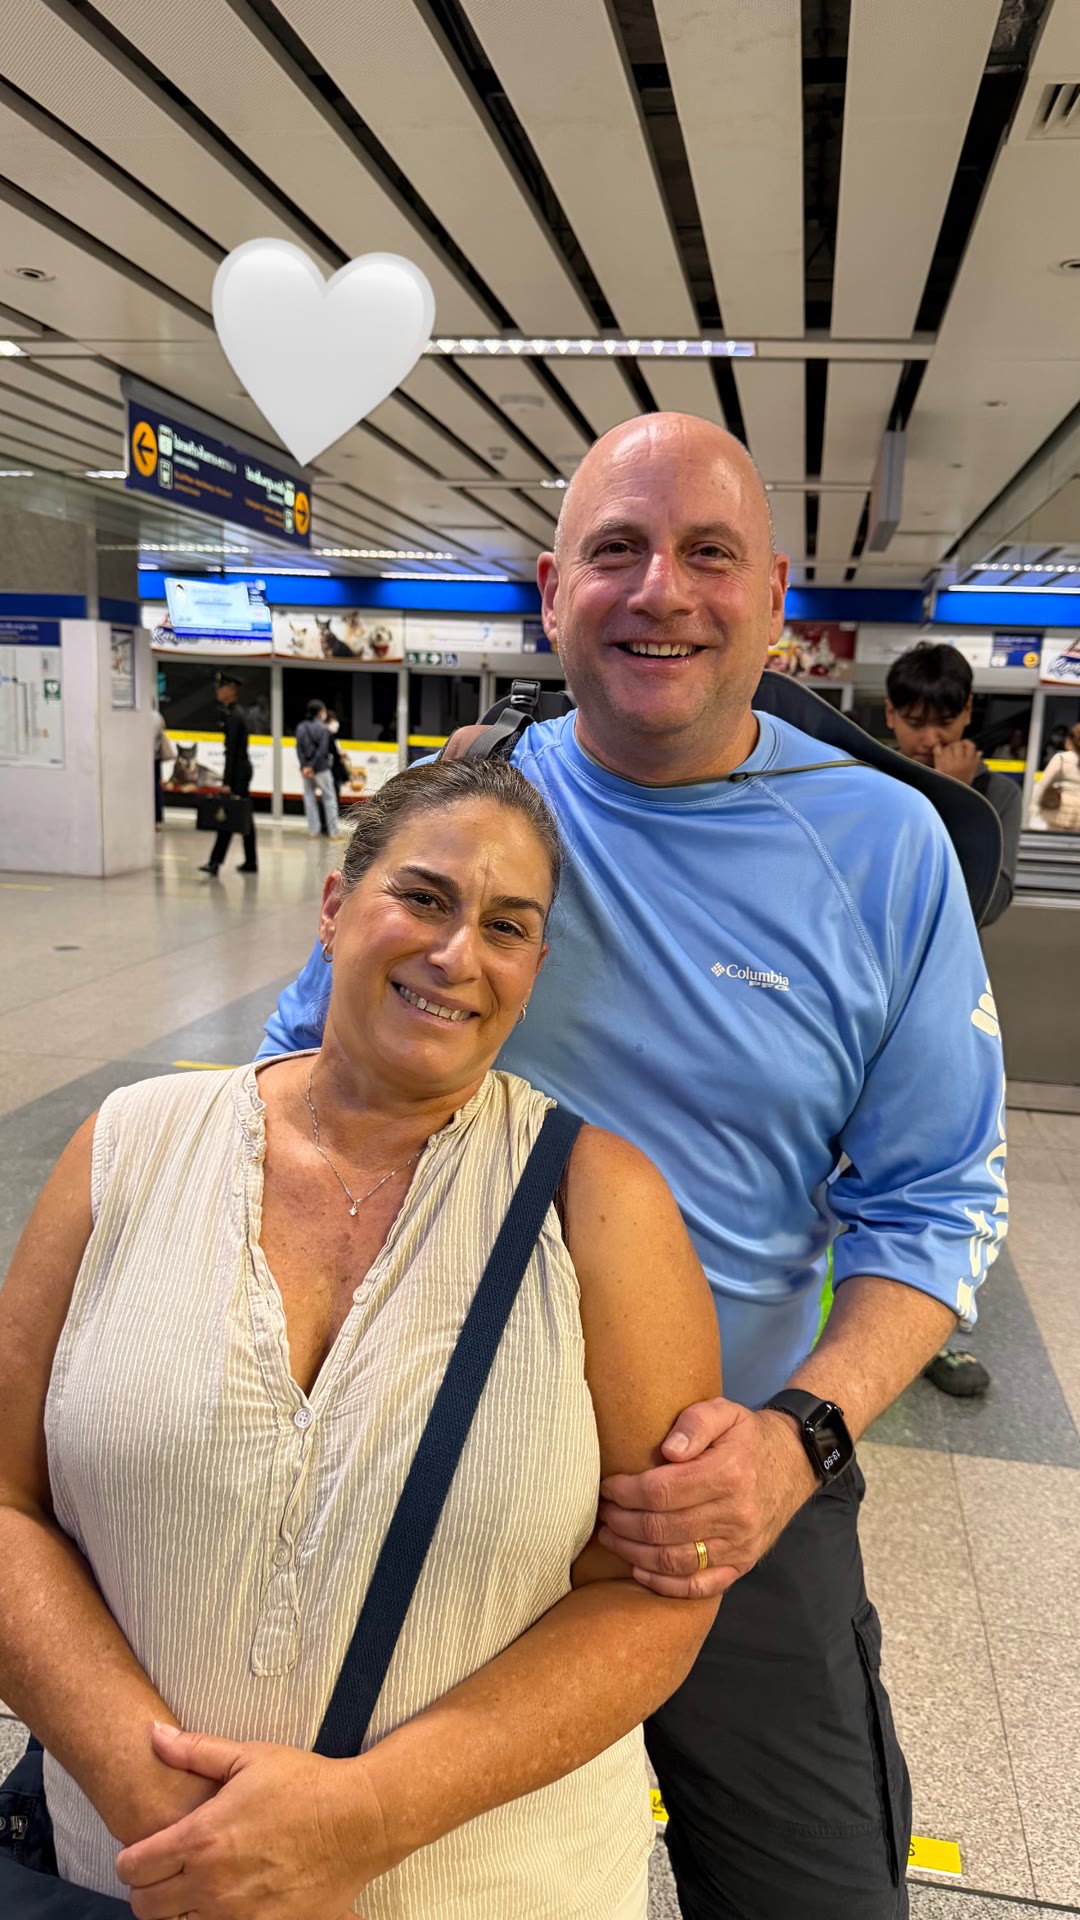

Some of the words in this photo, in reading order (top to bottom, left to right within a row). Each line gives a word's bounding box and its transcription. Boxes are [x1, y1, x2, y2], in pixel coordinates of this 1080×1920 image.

[726, 964, 789, 986] Columbia
[749, 980, 790, 992] PFG
[823, 1449, 840, 1470] 13:50
